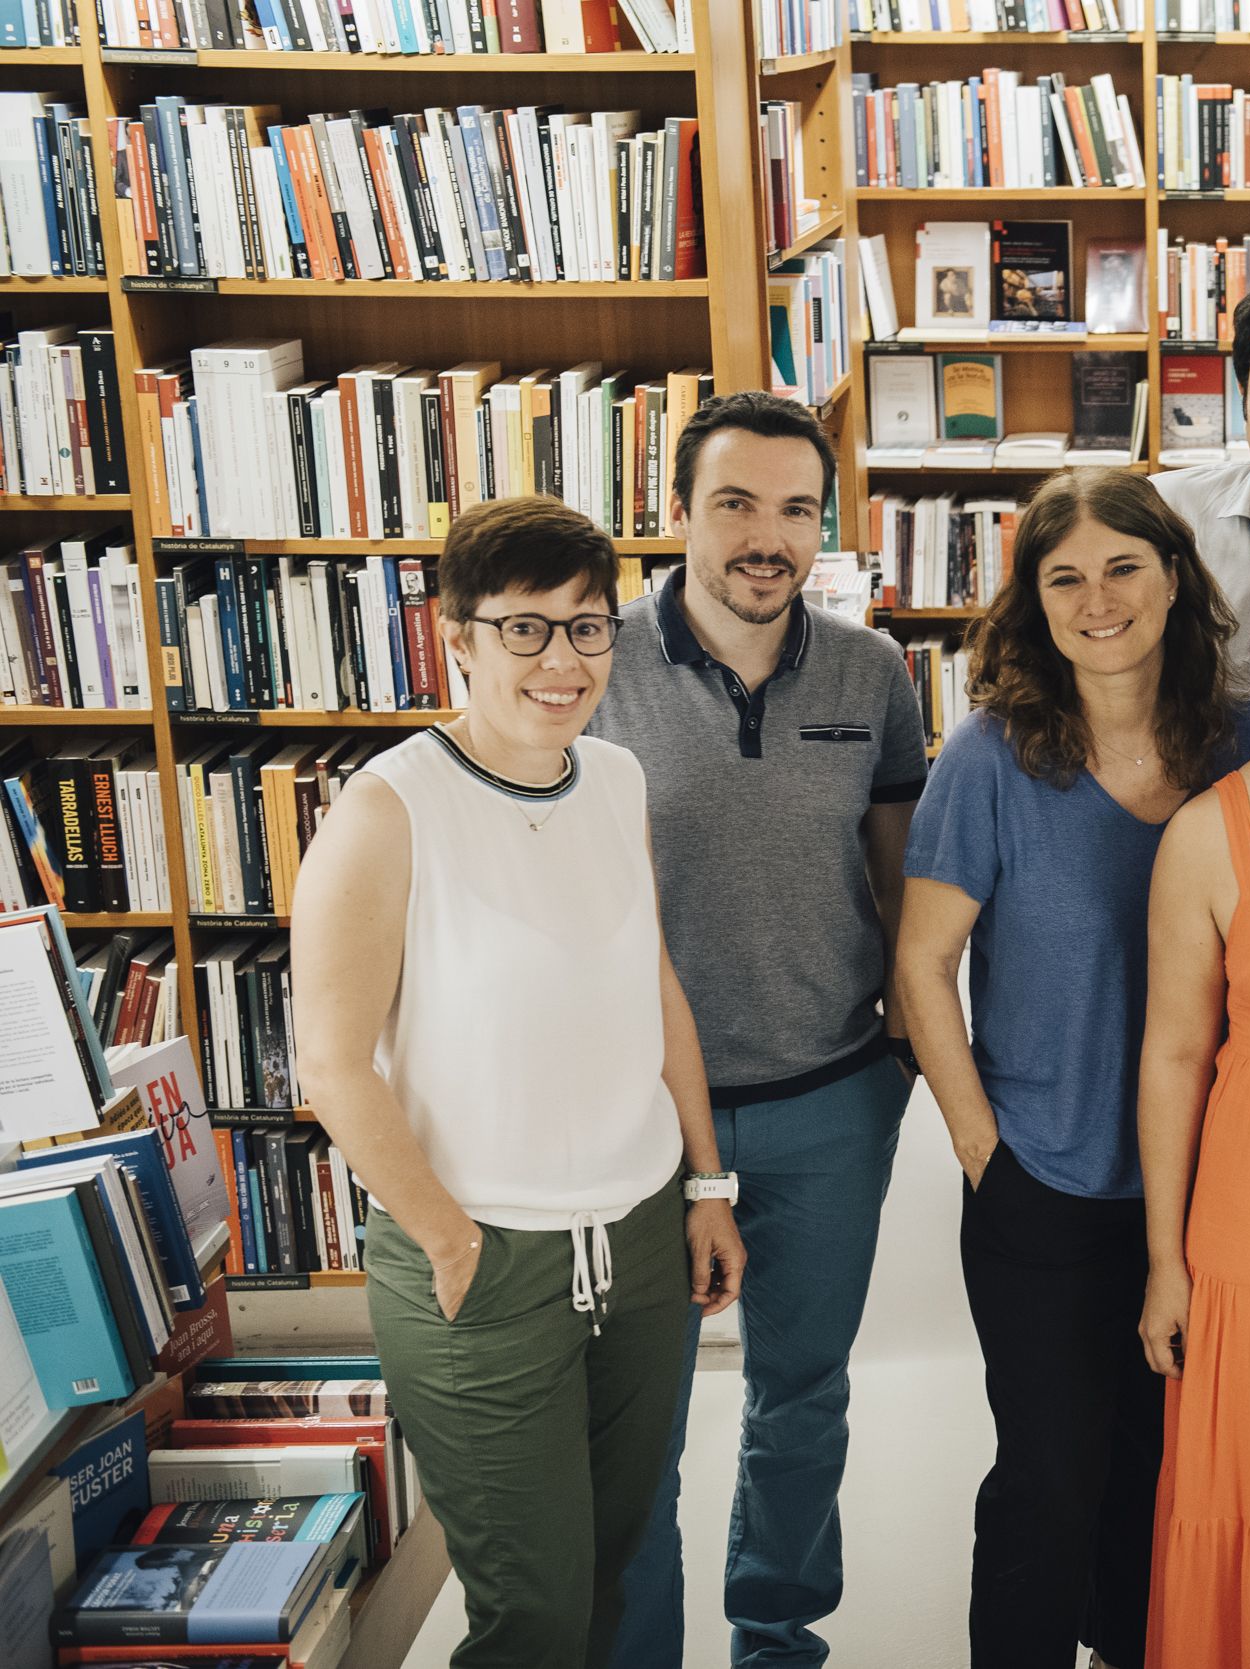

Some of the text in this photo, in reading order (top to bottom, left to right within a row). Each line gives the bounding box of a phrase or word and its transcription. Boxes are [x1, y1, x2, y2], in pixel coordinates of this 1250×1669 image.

[544, 165, 554, 190] PERSONAL
[547, 189, 554, 197] DE
[548, 196, 557, 221] CATALUÑA
[497, 197, 512, 251] MUÑOZ RAMONET
[130, 281, 205, 290] història de Catalunya
[197, 359, 209, 368] 12
[223, 360, 230, 368] 9
[243, 360, 255, 369] 10
[647, 409, 656, 431] després
[648, 431, 656, 445] anys
[648, 445, 656, 455] 45
[160, 542, 235, 550] història de Catalunya
[413, 611, 427, 688] Cambó en Argentina
[166, 651, 174, 666] JORDI
[179, 715, 250, 723] història de Catalunya
[59, 779, 84, 862] TARRADELLAS
[93, 773, 118, 862] ERNEST LLUCH
[198, 822, 206, 858] CATALUNYA
[195, 919, 267, 928] història de Catalunya
[212, 1113, 284, 1122] història de Catalunya
[231, 1279, 299, 1288] història de Catalunya
[169, 1308, 219, 1357] Joan Brossa,
[176, 1326, 215, 1362] ara i aquí
[70, 1438, 132, 1491] SER JOAN
[71, 1456, 134, 1513] FUSTER
